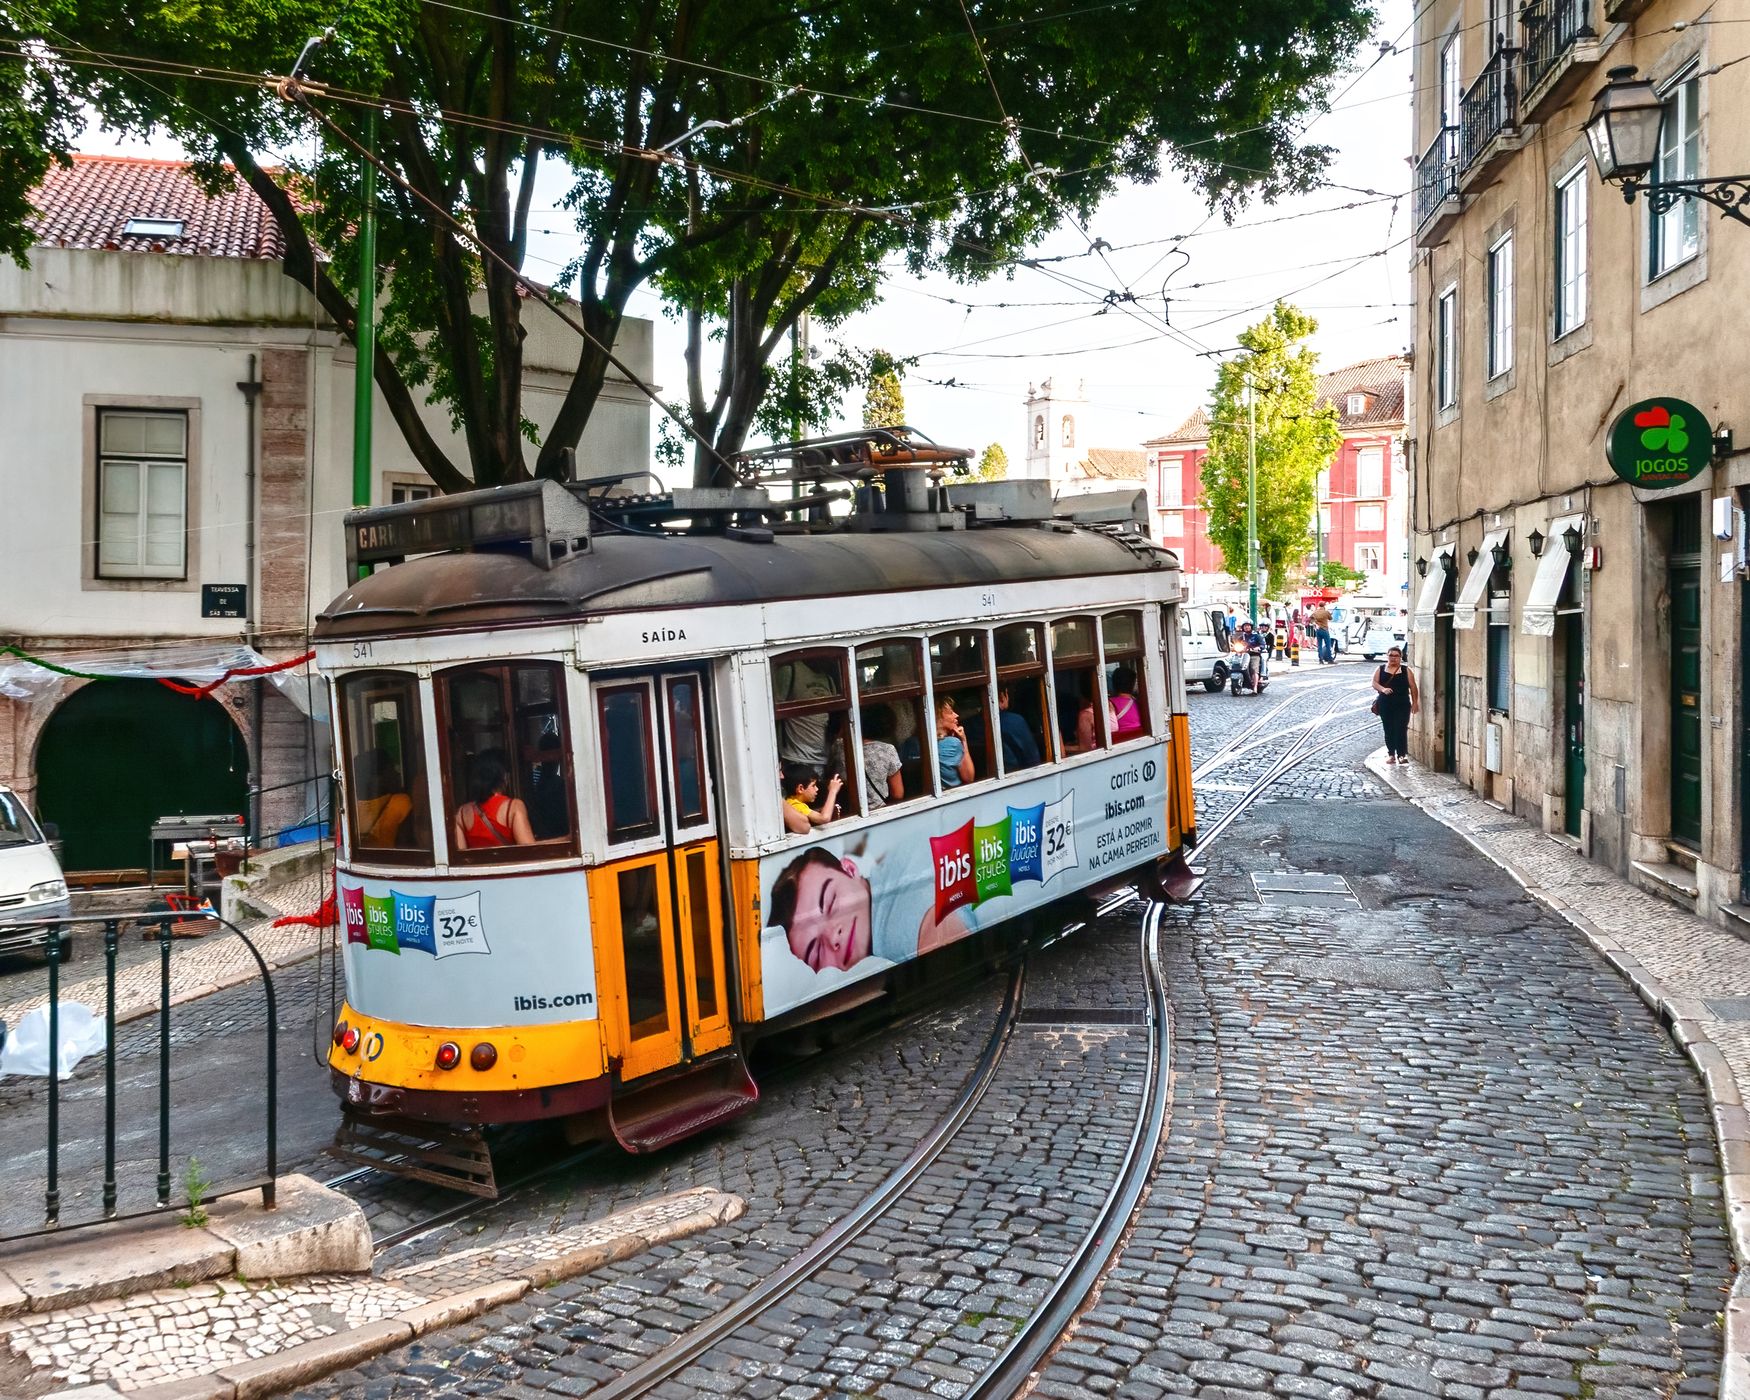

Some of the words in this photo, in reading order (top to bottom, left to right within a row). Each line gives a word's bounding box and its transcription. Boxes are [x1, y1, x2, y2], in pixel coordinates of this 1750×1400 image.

[1635, 457, 1689, 478] JOGOS
[983, 594, 996, 607] 541
[641, 627, 687, 643] SAÍDA
[353, 642, 373, 659] 541
[1110, 764, 1138, 790] carris
[1105, 794, 1145, 820] ibis.com
[1015, 820, 1036, 845] ibis
[1046, 820, 1072, 856] 32€
[1097, 827, 1116, 849] ESTÁ
[1117, 828, 1123, 840] A
[1124, 817, 1153, 838] DORMIR
[981, 836, 1003, 863] ibis
[1010, 844, 1039, 863] budget
[1089, 855, 1101, 870] NA
[1102, 847, 1125, 865] CAMA
[1126, 831, 1160, 855] PERFEITA!
[939, 849, 971, 890] ibis
[345, 902, 364, 926] ibis
[369, 905, 388, 924] ibis
[400, 902, 425, 923] ibis
[396, 919, 430, 937] budget
[440, 915, 478, 938] 32€
[514, 992, 593, 1011] ibis.com
